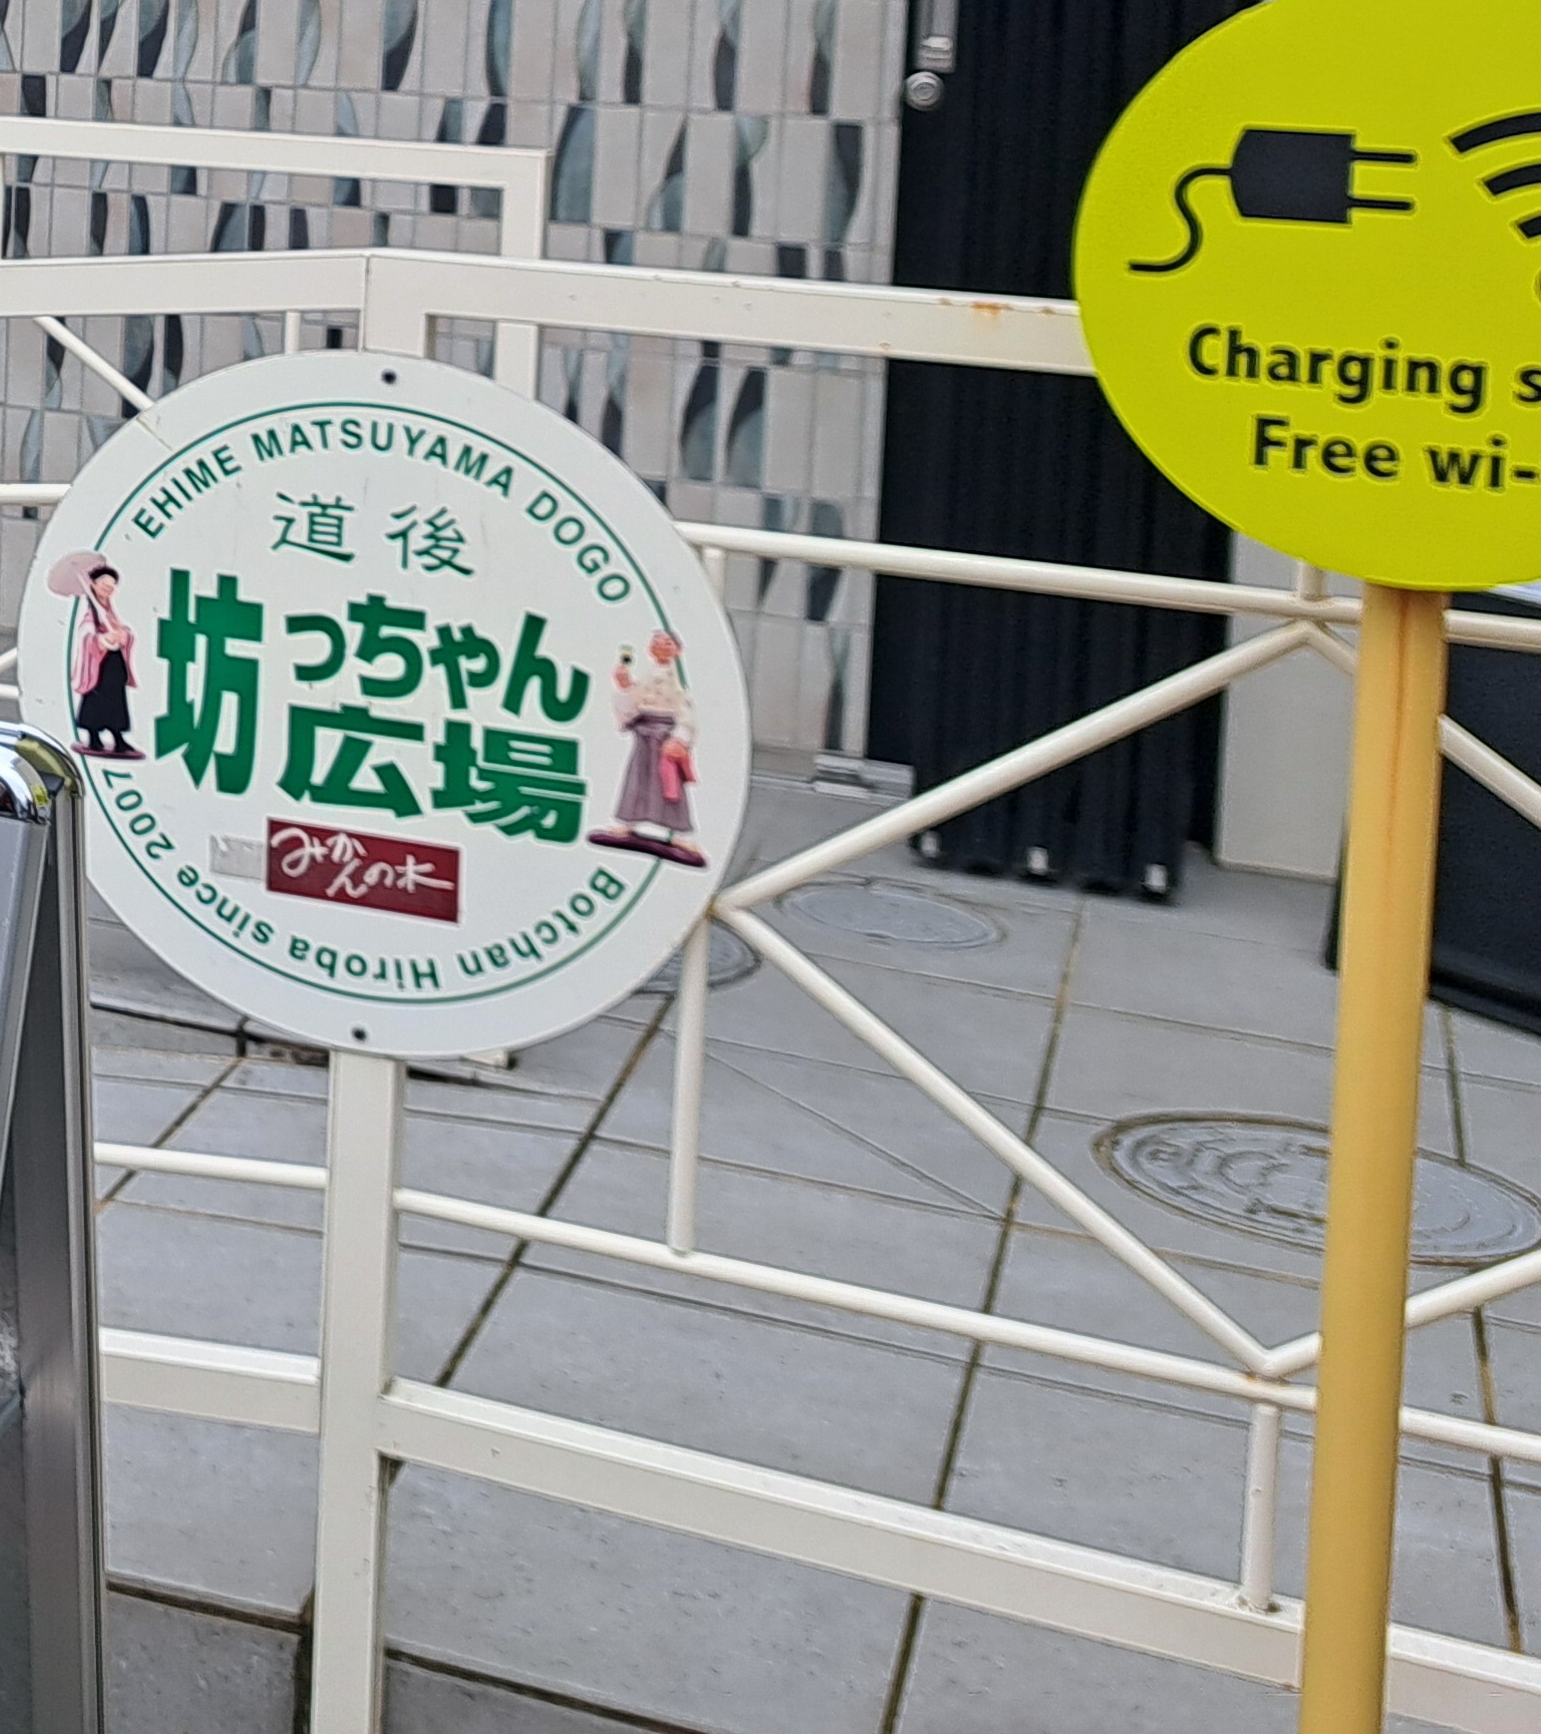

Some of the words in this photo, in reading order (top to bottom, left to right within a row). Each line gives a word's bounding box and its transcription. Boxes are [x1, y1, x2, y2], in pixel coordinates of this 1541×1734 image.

[1187, 325, 1491, 415] Charging
[1253, 414, 1402, 480] Free
[1424, 434, 1541, 490] wi-
[132, 444, 243, 541] EHIME
[251, 418, 516, 499] MATSUYAMA
[523, 486, 633, 607] DOGO
[269, 489, 476, 578] 道後
[154, 567, 592, 795] 坊っちゃん
[100, 768, 176, 862] 2007
[277, 703, 590, 846] 広場
[175, 861, 275, 948] since
[455, 865, 627, 981] Botchan
[288, 932, 442, 992] Hiroba
